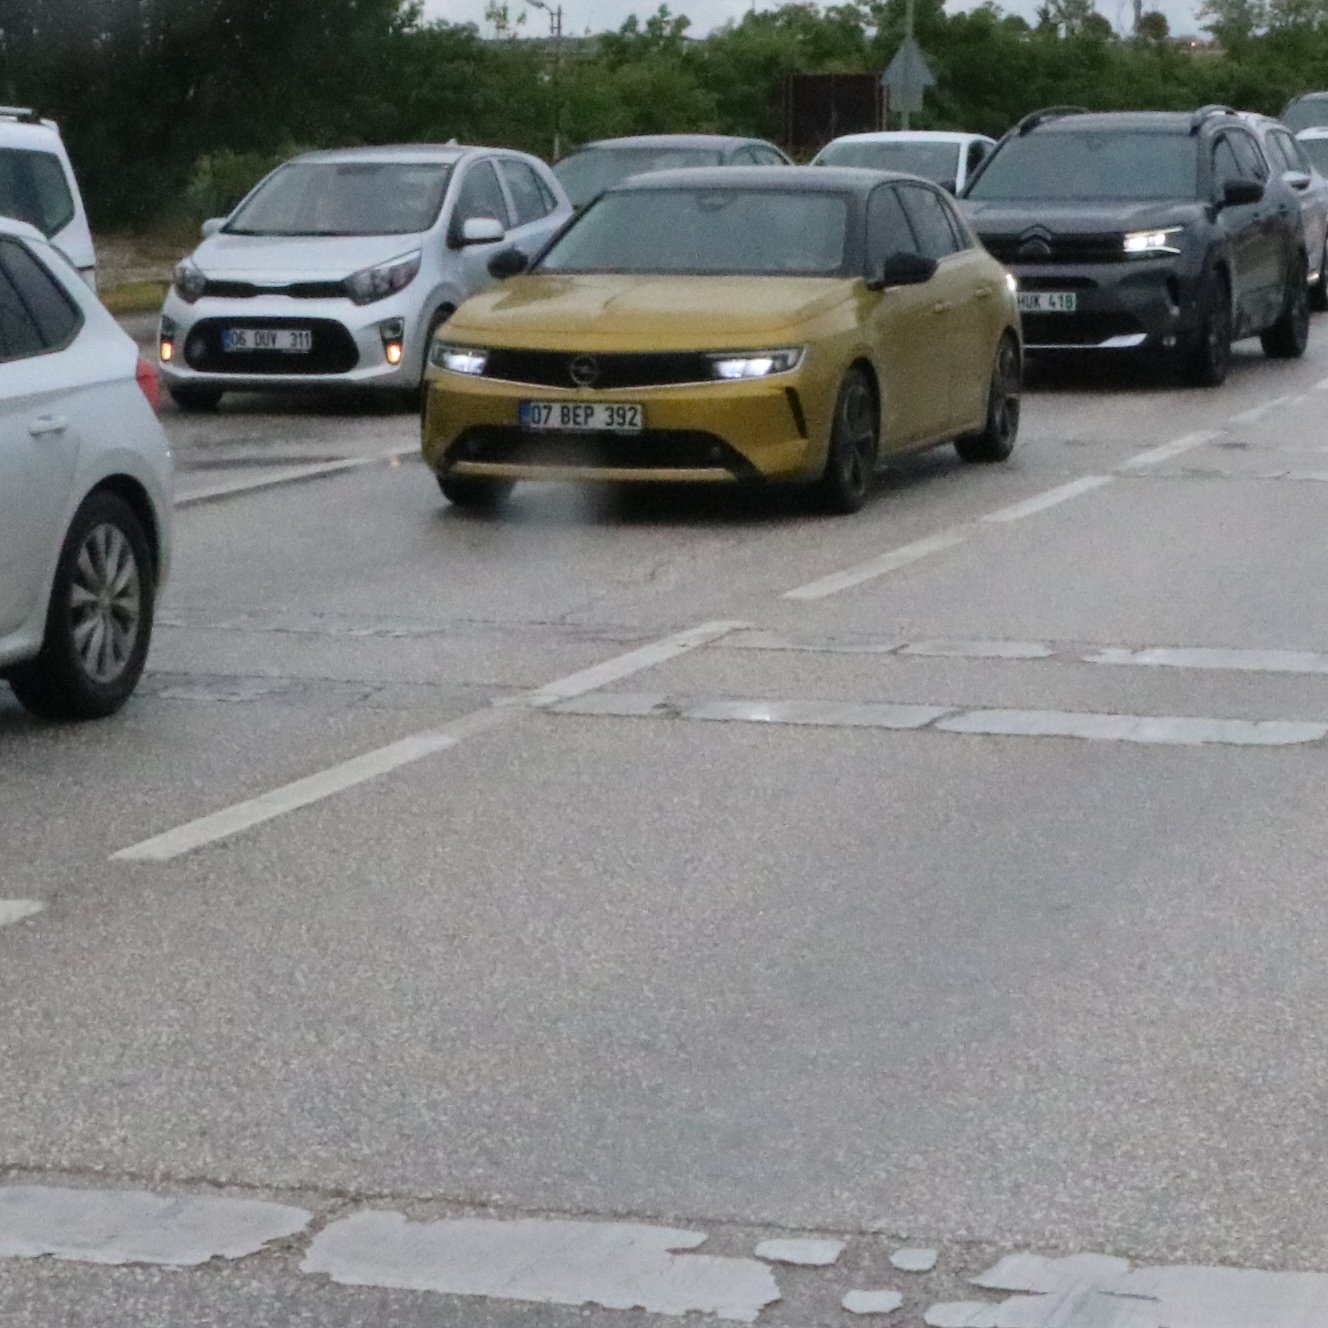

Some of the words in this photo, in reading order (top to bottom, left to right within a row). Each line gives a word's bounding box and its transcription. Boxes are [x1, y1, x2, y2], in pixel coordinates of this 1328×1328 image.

[532, 404, 552, 425] 07
[560, 404, 594, 426] BEP
[604, 405, 638, 427] 392
